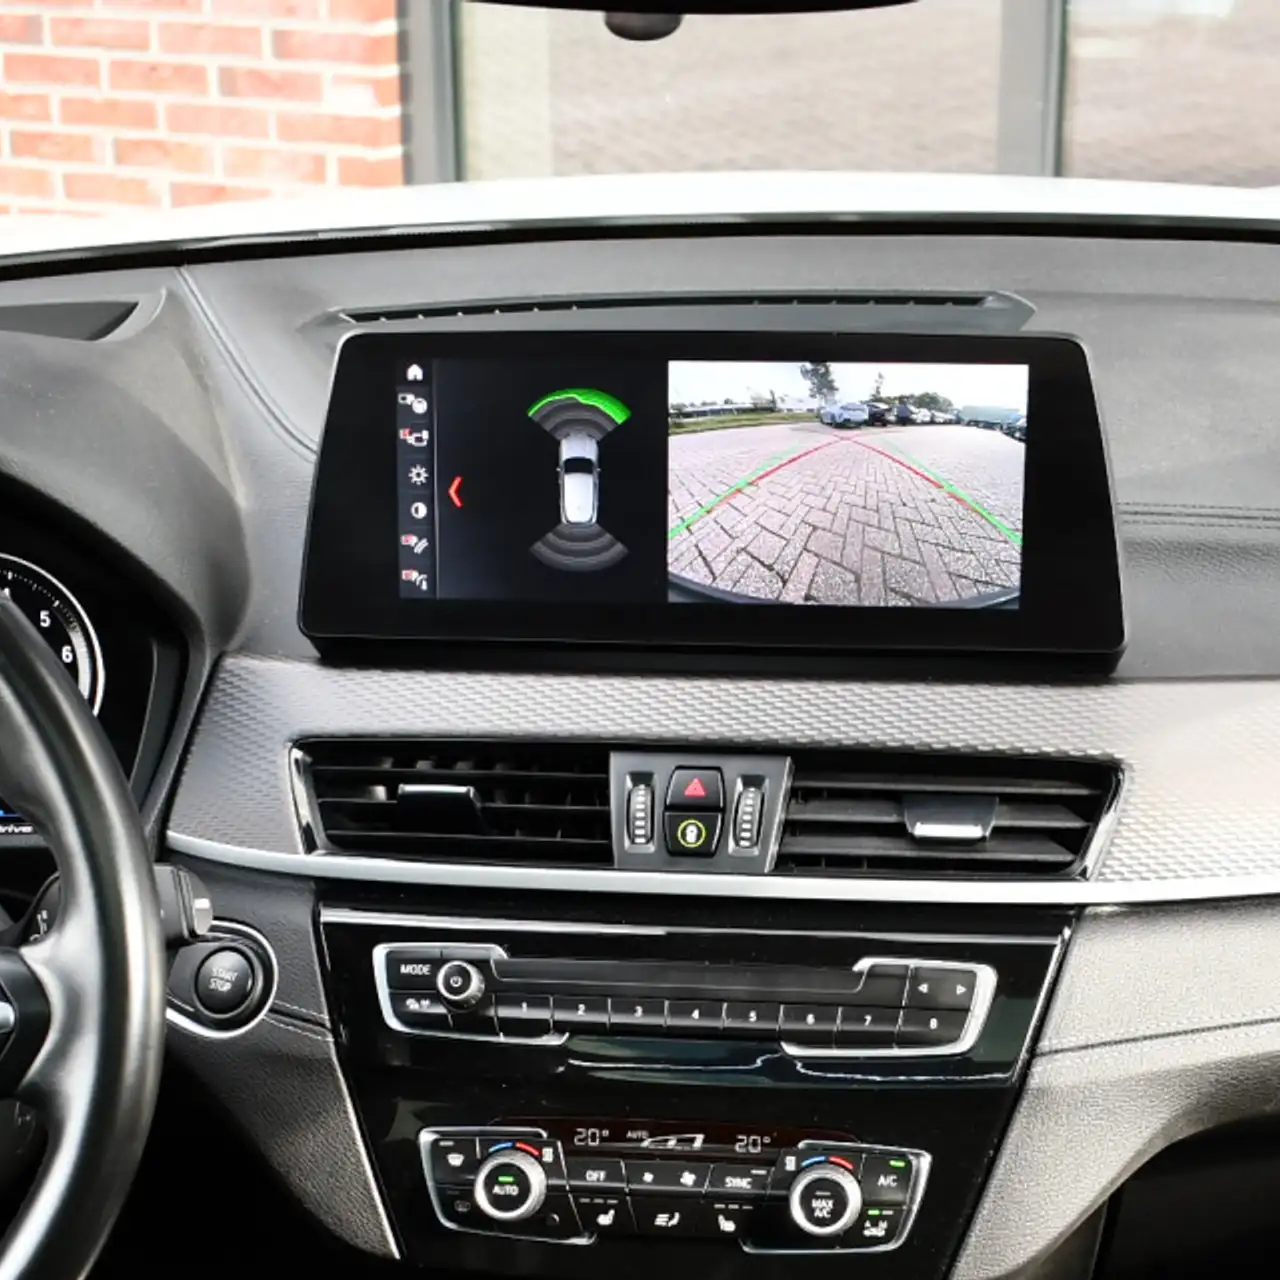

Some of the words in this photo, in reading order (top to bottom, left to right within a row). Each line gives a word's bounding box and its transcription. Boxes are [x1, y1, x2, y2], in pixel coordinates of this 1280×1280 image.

[40, 610, 51, 628] 5
[62, 645, 73, 663] 6
[400, 963, 431, 976] MODE
[521, 1001, 528, 1013] 1
[577, 1003, 586, 1016] 2
[634, 1005, 643, 1017] 3
[690, 1008, 700, 1020] 4
[748, 1010, 758, 1023] 5
[806, 1013, 815, 1025] 6
[863, 1015, 872, 1027] 7
[928, 1017, 938, 1030] 8
[585, 1170, 607, 1182] OFF
[877, 1175, 898, 1188] A/C
[725, 1176, 752, 1190] SYNC
[492, 1185, 519, 1196] AUTO
[812, 1199, 834, 1210] MAX
